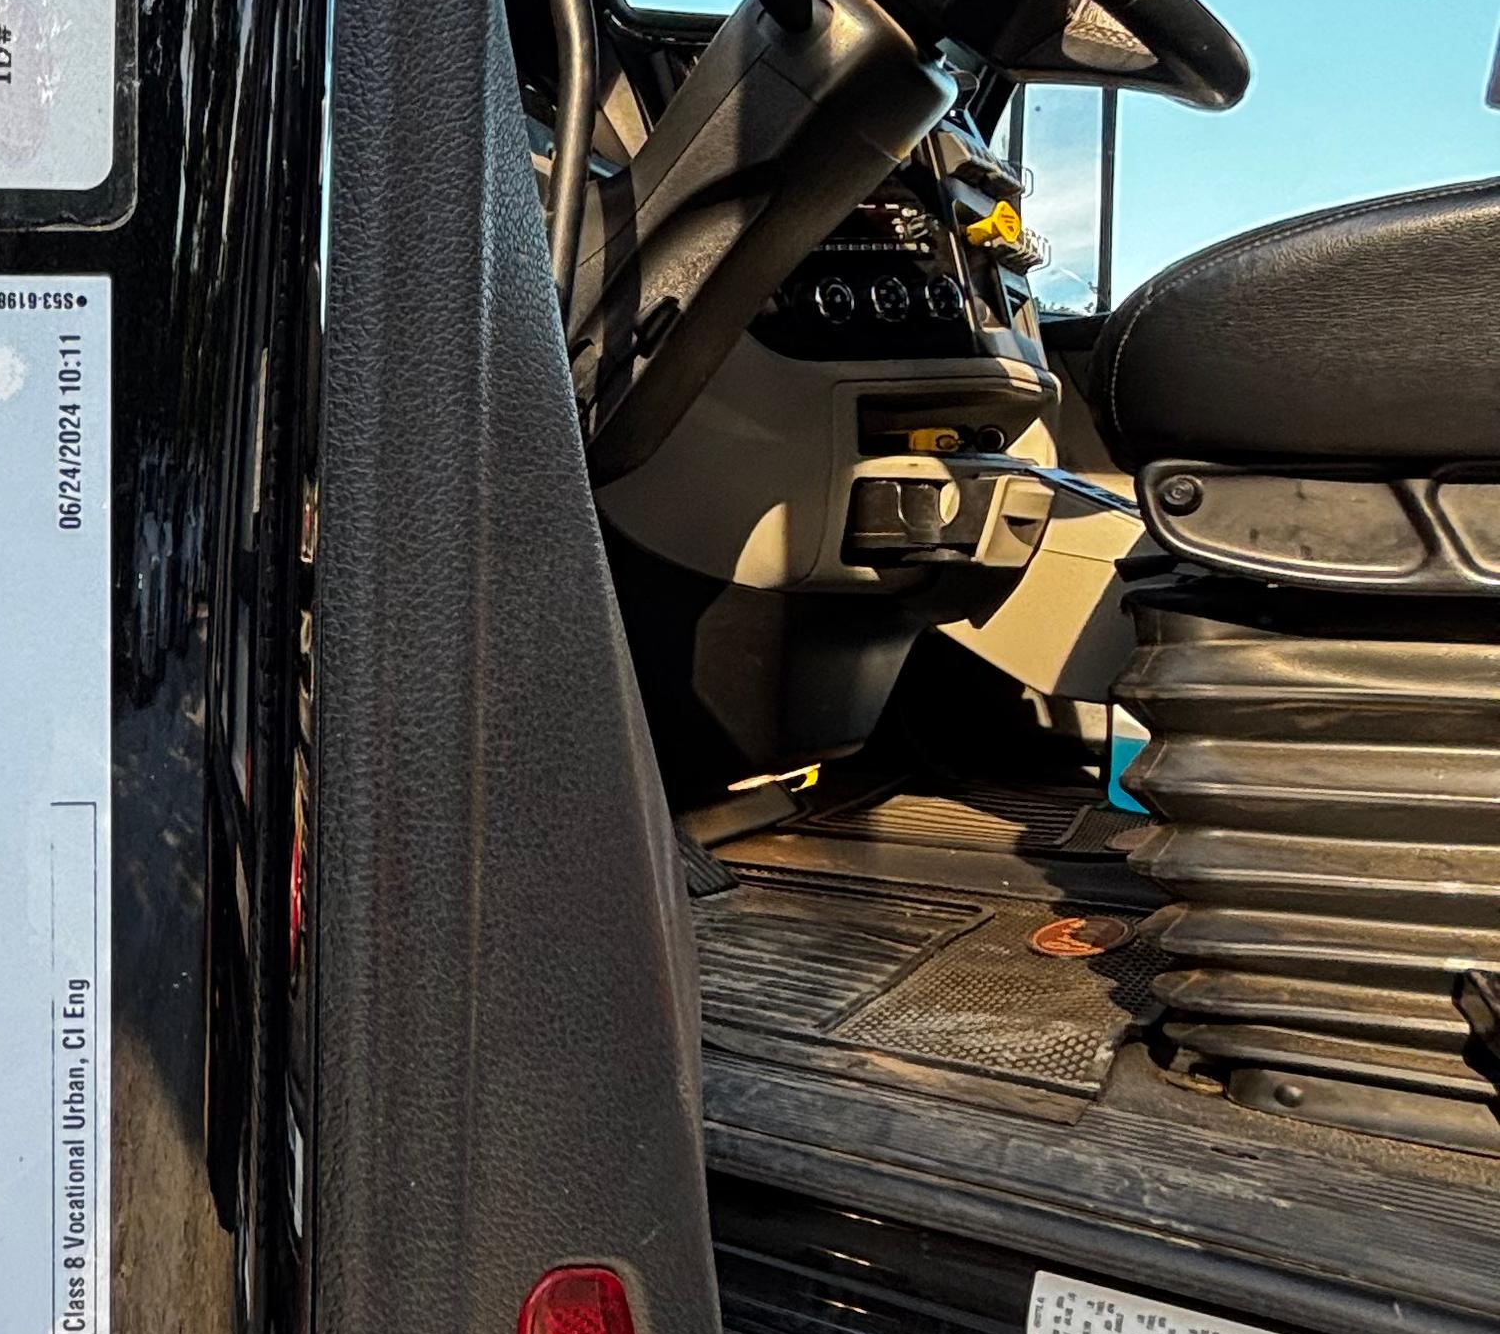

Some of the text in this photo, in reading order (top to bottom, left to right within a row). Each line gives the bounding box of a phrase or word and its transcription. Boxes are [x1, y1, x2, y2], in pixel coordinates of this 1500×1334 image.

[57, 333, 82, 529] 06/24/2024 10:11
[62, 977, 90, 1018] Eng
[62, 1056, 89, 1130] Urban,
[61, 1138, 86, 1249] Vocational
[62, 1255, 86, 1269] 8
[62, 1275, 86, 1331] Class
